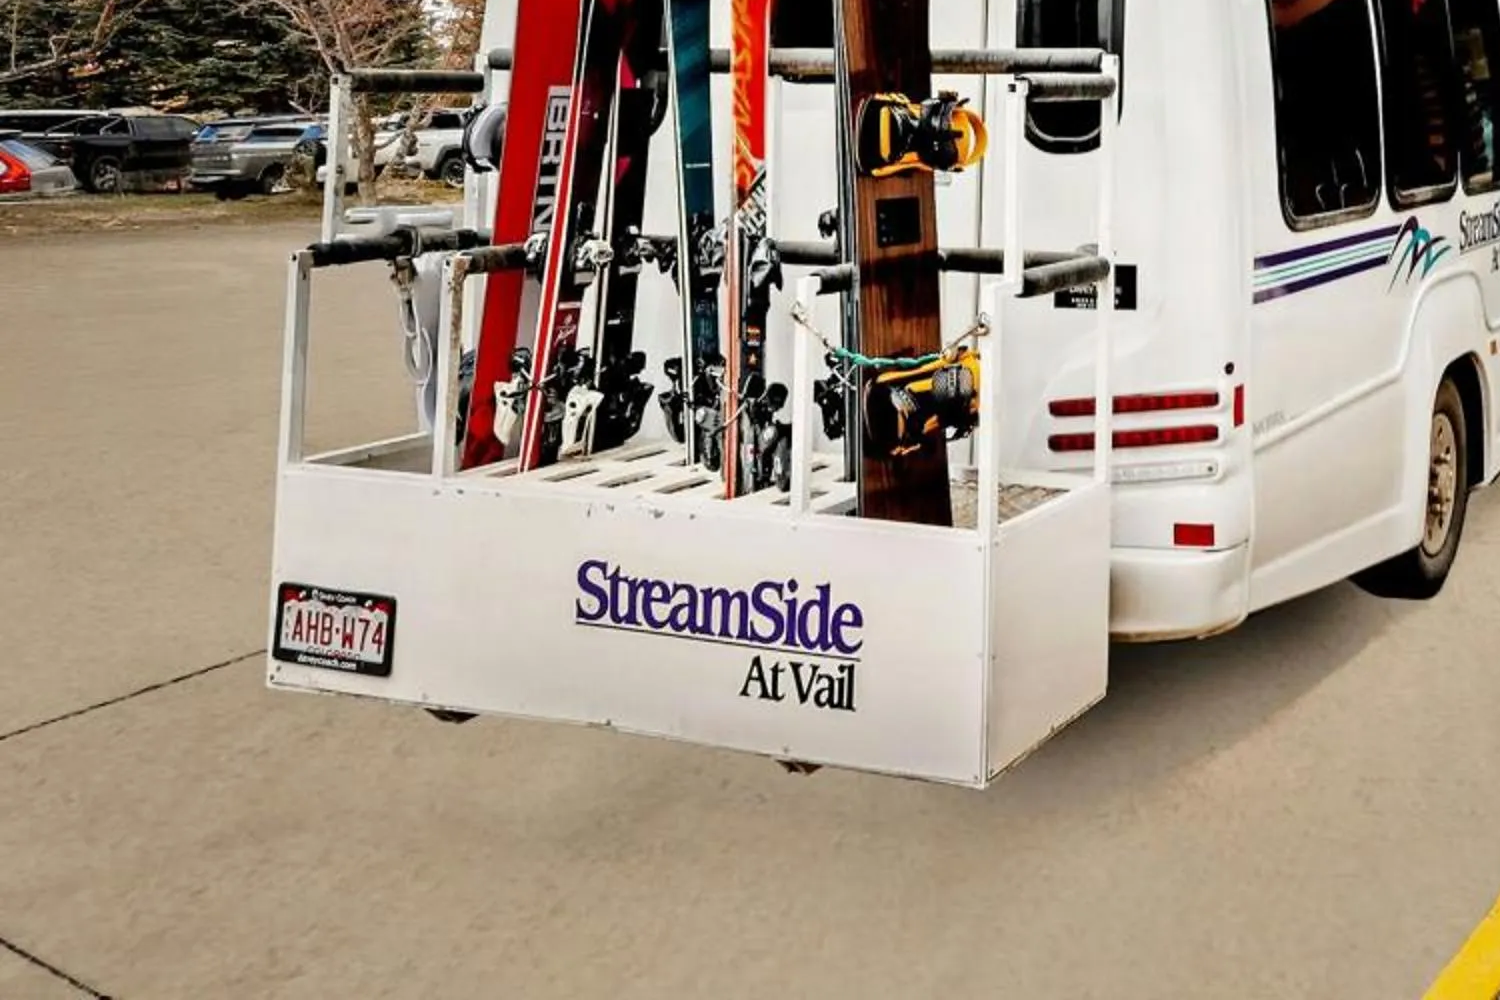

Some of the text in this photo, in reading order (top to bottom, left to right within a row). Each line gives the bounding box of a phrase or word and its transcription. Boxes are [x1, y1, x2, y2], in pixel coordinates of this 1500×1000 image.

[575, 559, 863, 654] StreamSide
[739, 654, 857, 712] At Vail
